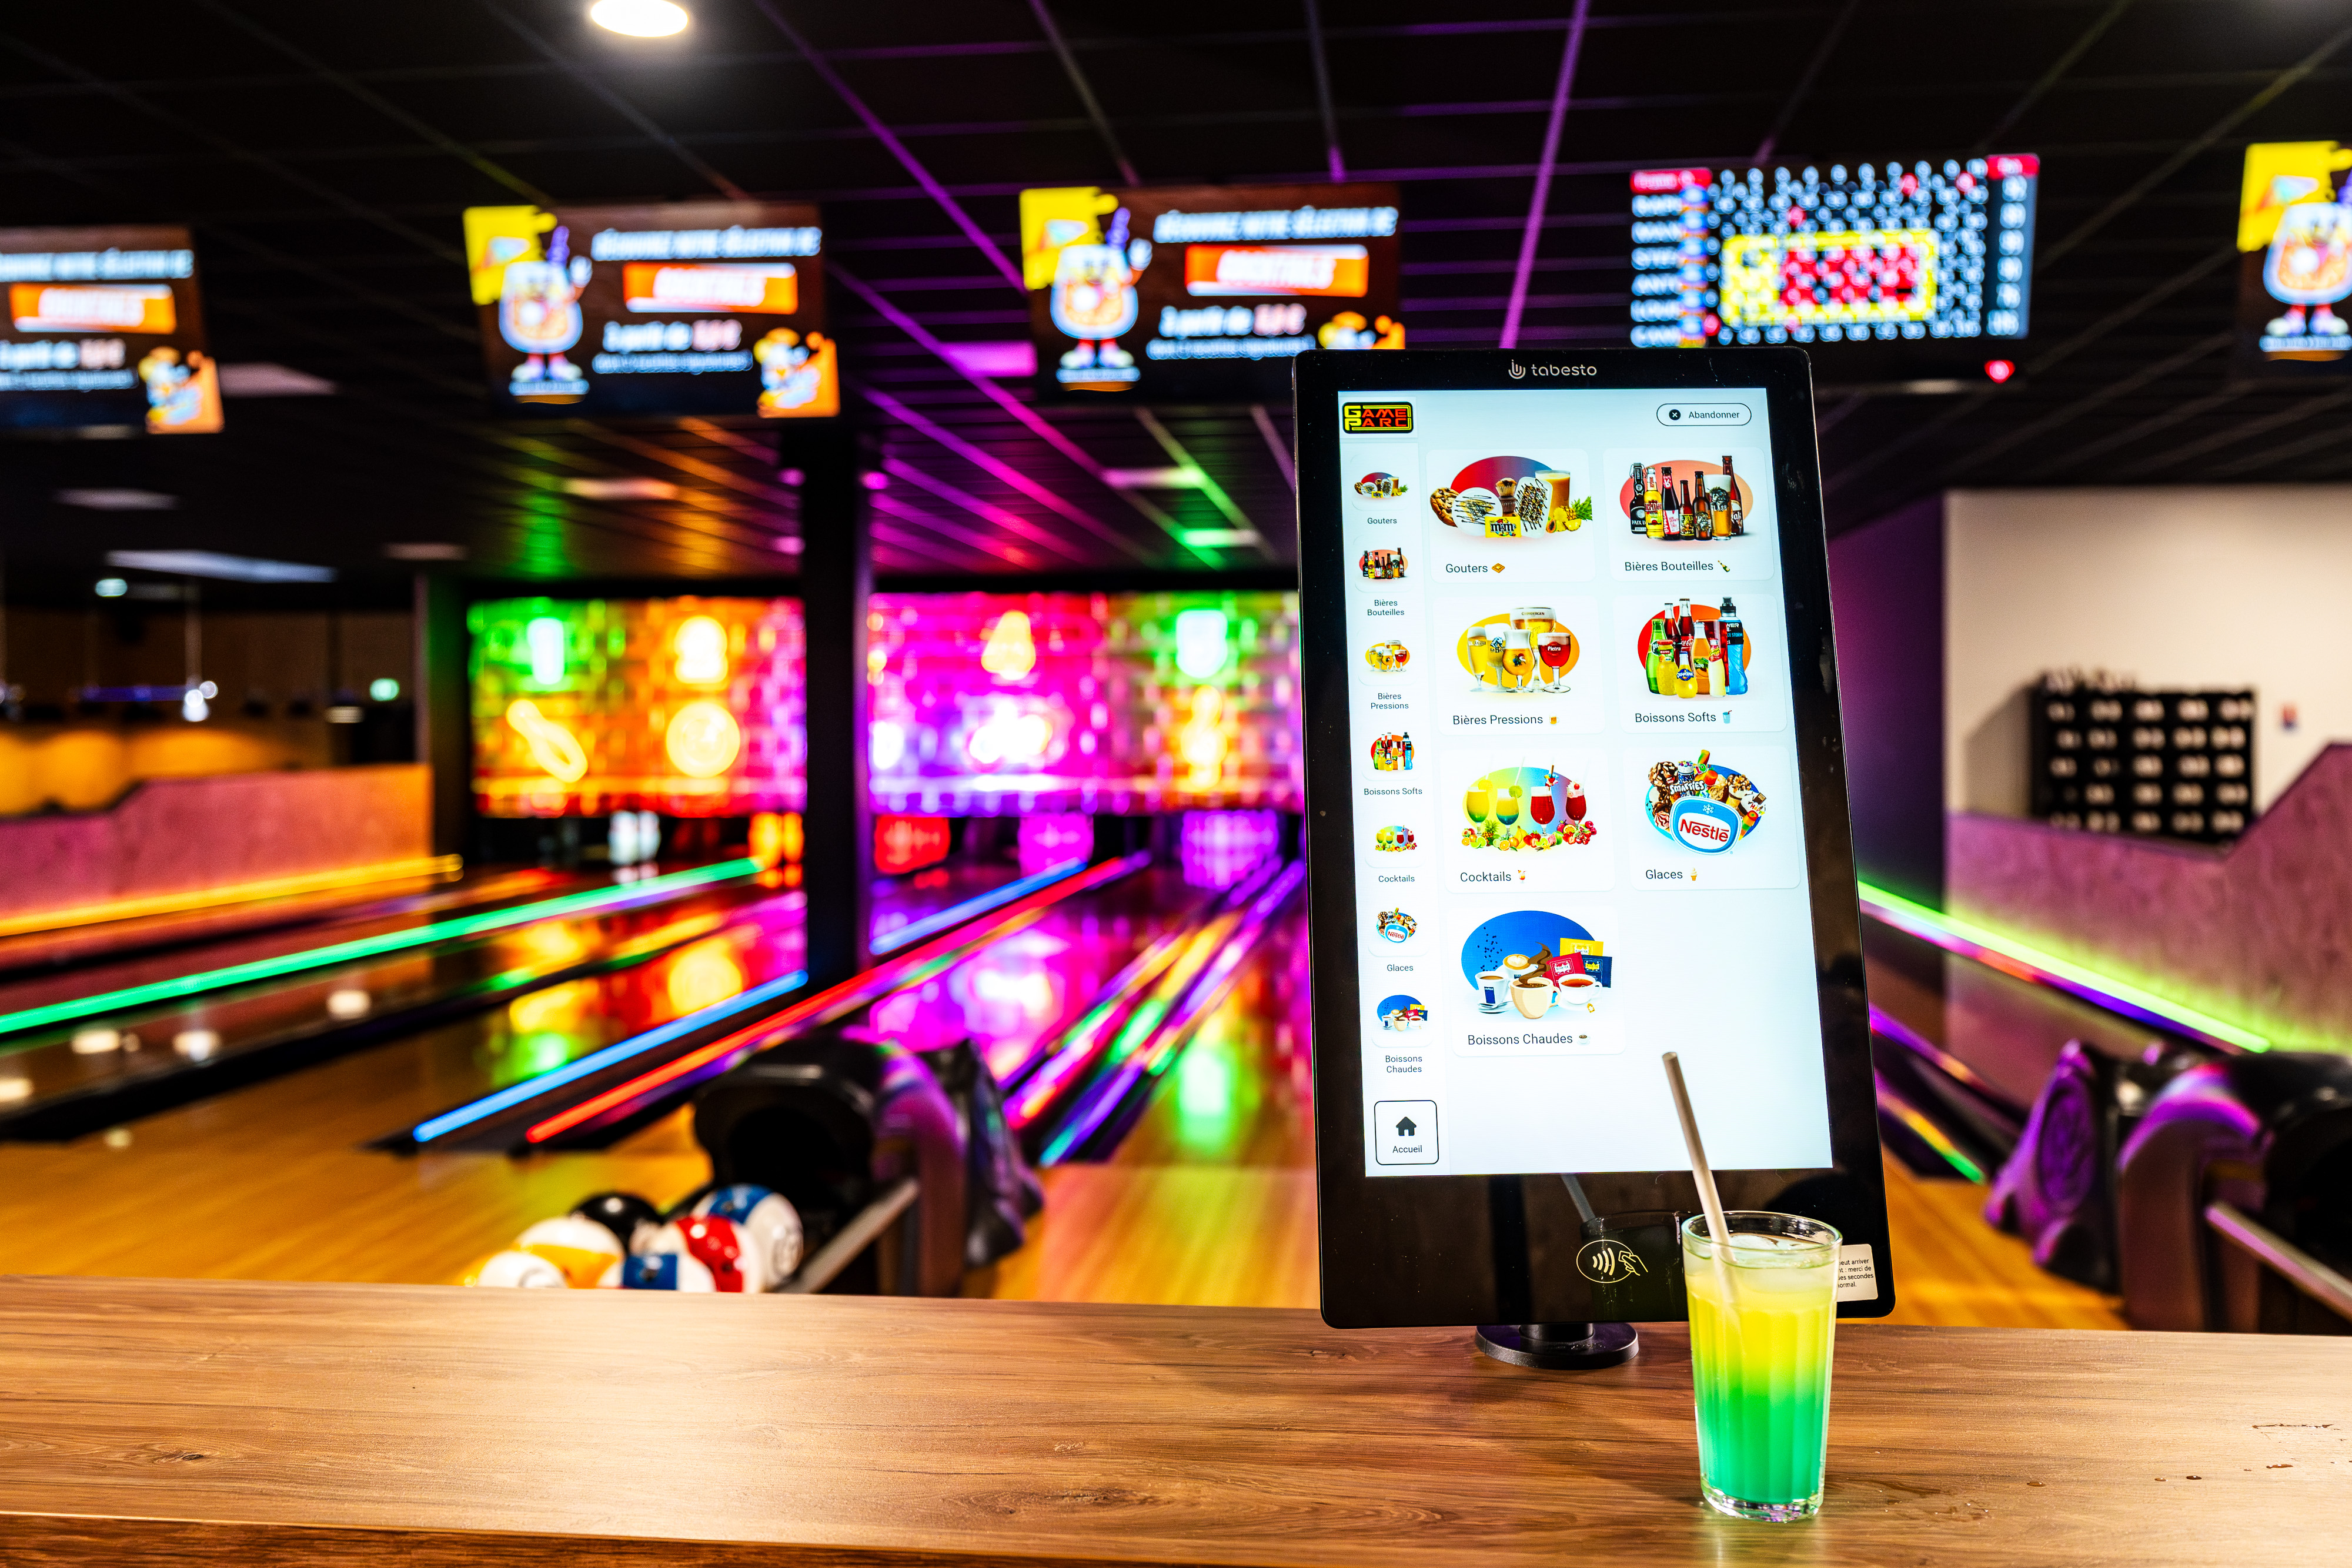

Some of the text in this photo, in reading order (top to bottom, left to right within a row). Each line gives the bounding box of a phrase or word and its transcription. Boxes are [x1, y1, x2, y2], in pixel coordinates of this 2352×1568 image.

[1531, 364, 1597, 376] tabesto
[1344, 405, 1407, 418] GAME
[1688, 410, 1740, 419] Abandonner
[1344, 418, 1407, 431] PARC
[1445, 563, 1488, 573] Gouters
[1625, 560, 1713, 571] Bières Bouteilles
[1453, 714, 1544, 725] Bières Pressions
[1635, 711, 1716, 723] Boissons Softs
[1378, 874, 1415, 882] Cocktails
[1460, 871, 1512, 882] Cocktails
[1645, 869, 1683, 880] Glaces
[1387, 964, 1414, 972] Glaces
[1468, 1032, 1573, 1045] Boissons Chaudes
[1385, 1055, 1422, 1063] Boissons
[1386, 1065, 1422, 1073] Chaudes
[1392, 1145, 1422, 1154] Accueil
